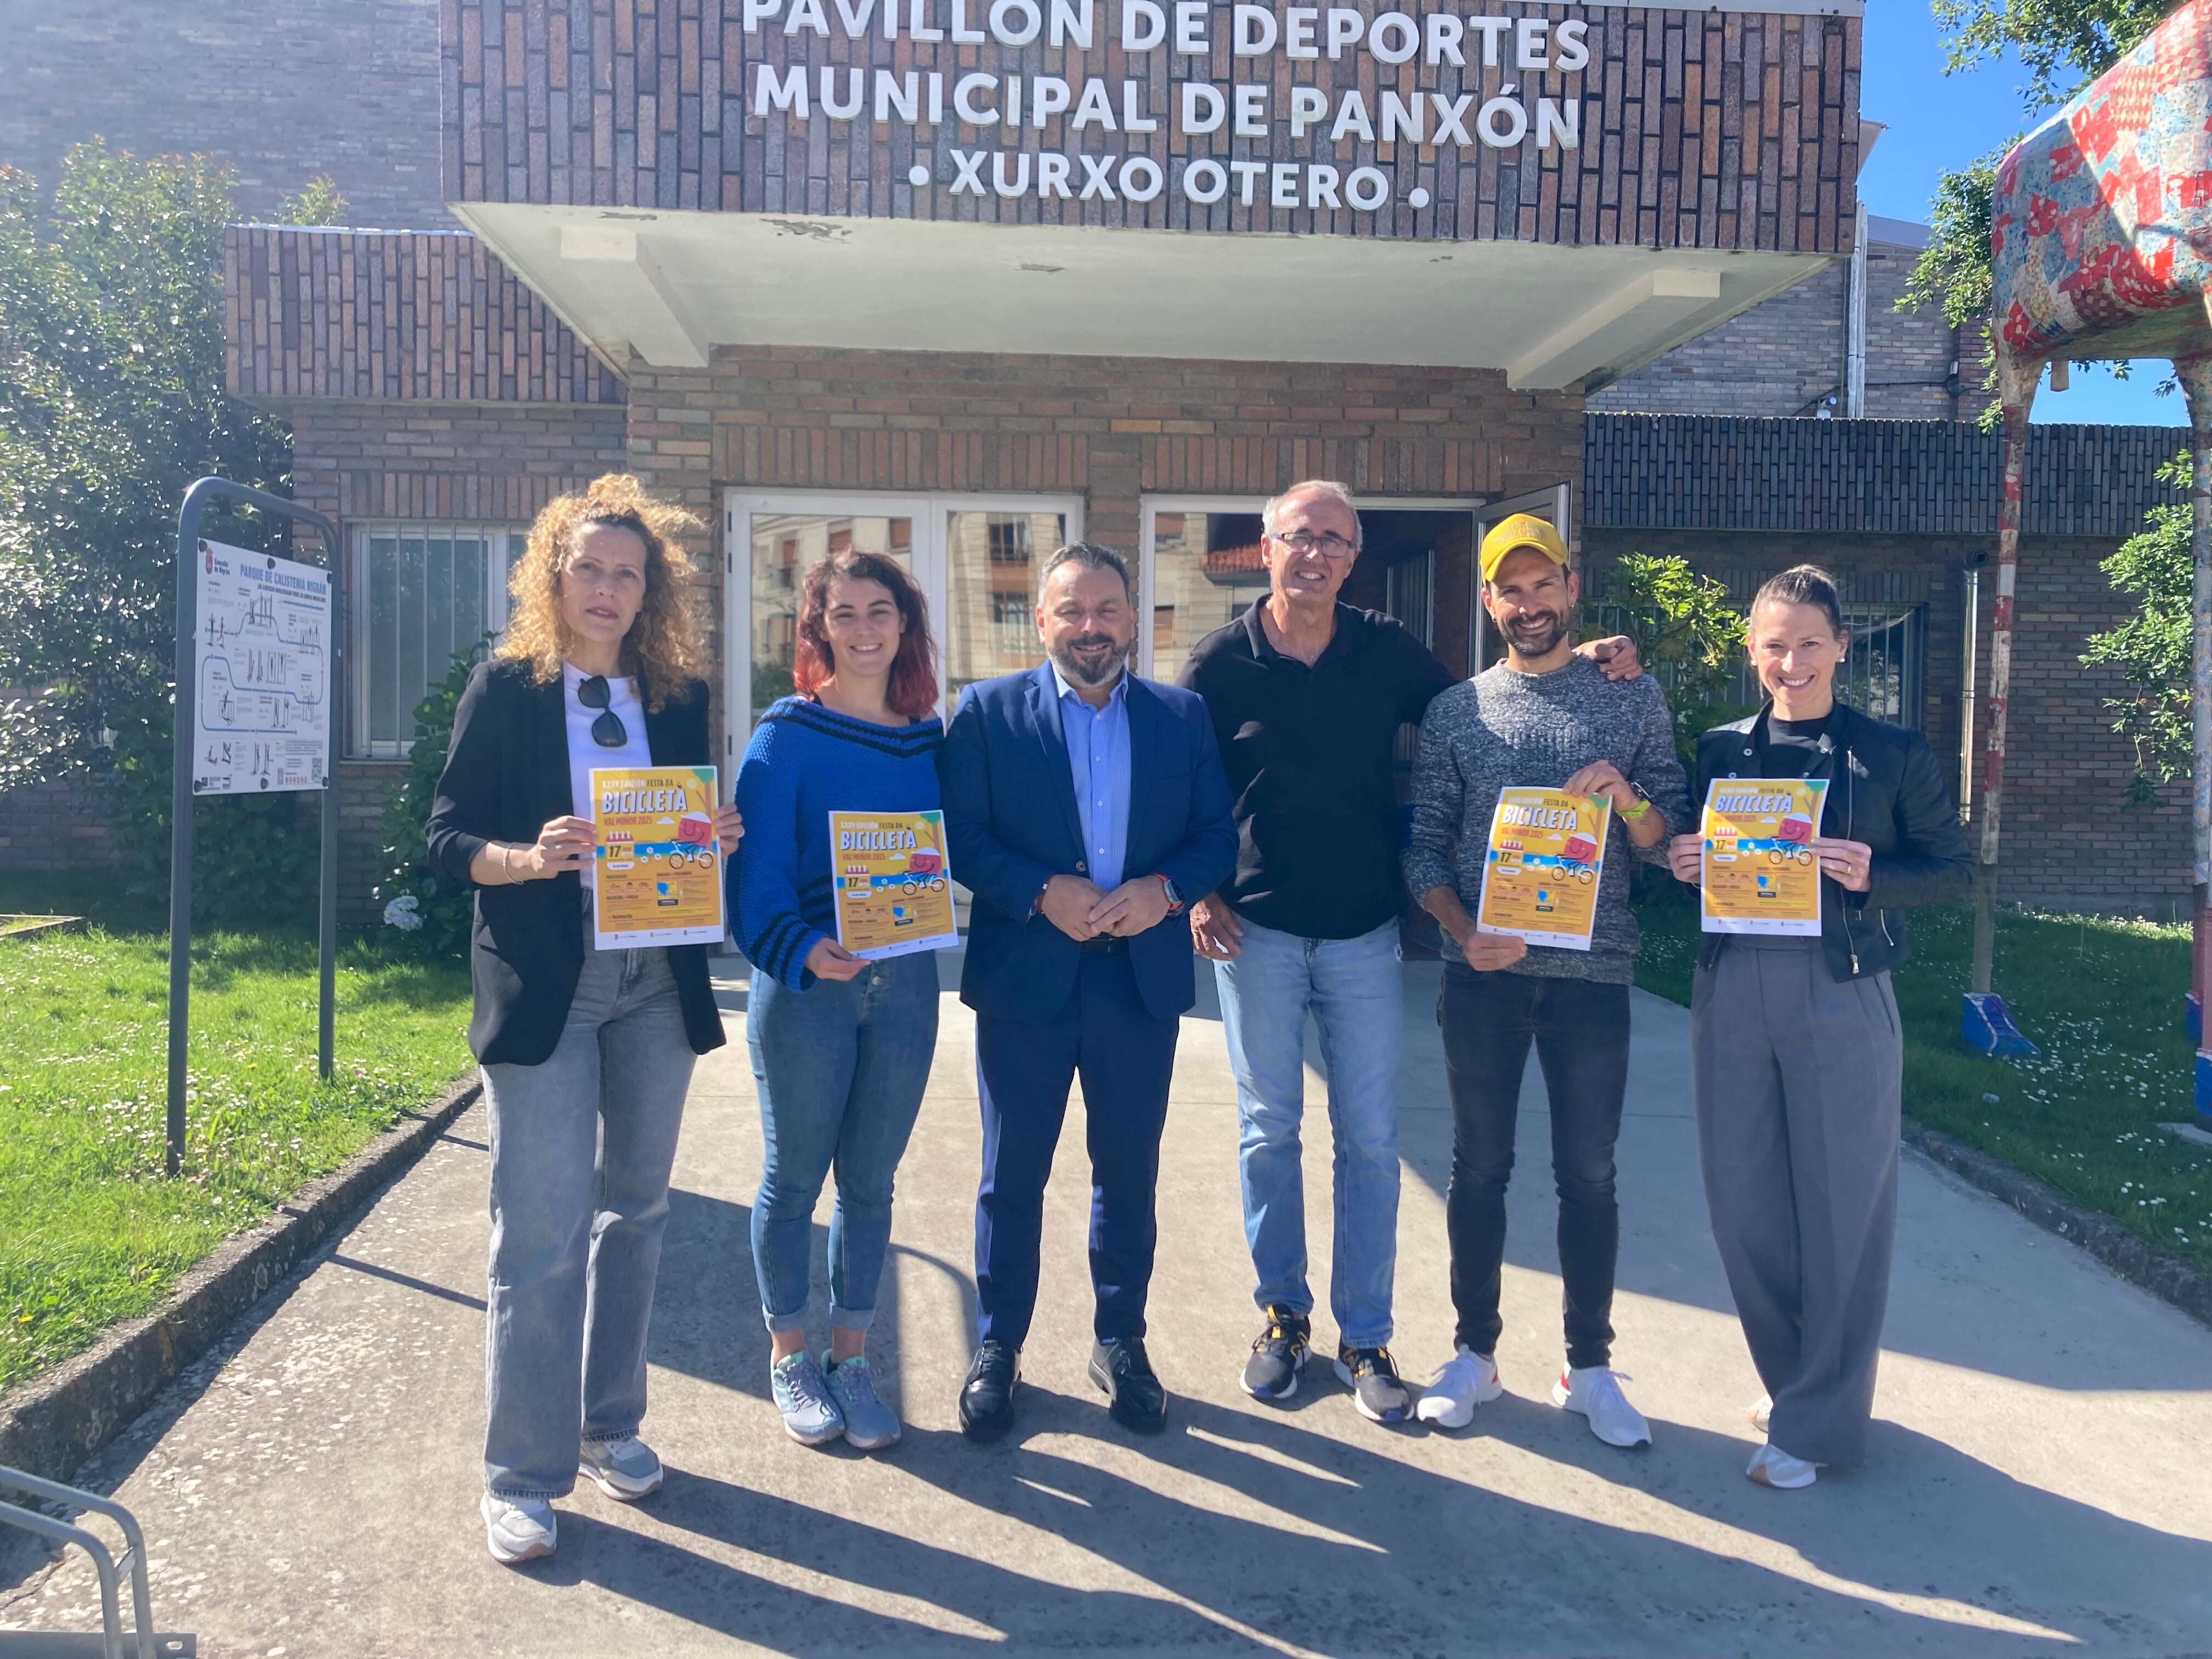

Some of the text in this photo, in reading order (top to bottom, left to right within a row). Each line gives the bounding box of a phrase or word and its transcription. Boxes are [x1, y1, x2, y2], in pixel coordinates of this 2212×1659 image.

[1122, 1, 1209, 55] DE
[1234, 4, 1589, 73] DEPORTES
[754, 64, 1578, 150] MUNICIPAL DE PANXÓN
[949, 149, 1389, 212] XURXO OTERO
[240, 564, 263, 582] PARQUE
[265, 570, 273, 583] DE
[274, 573, 306, 590] CALISTENIA
[307, 580, 326, 595] NIGRÁN
[1543, 798, 1559, 806] FESTA
[604, 817, 615, 826] VAL
[638, 816, 653, 825] 2025
[1716, 840, 1726, 850] 17
[609, 845, 621, 857] 17
[1501, 852, 1511, 862] 17
[848, 877, 859, 888] 17
